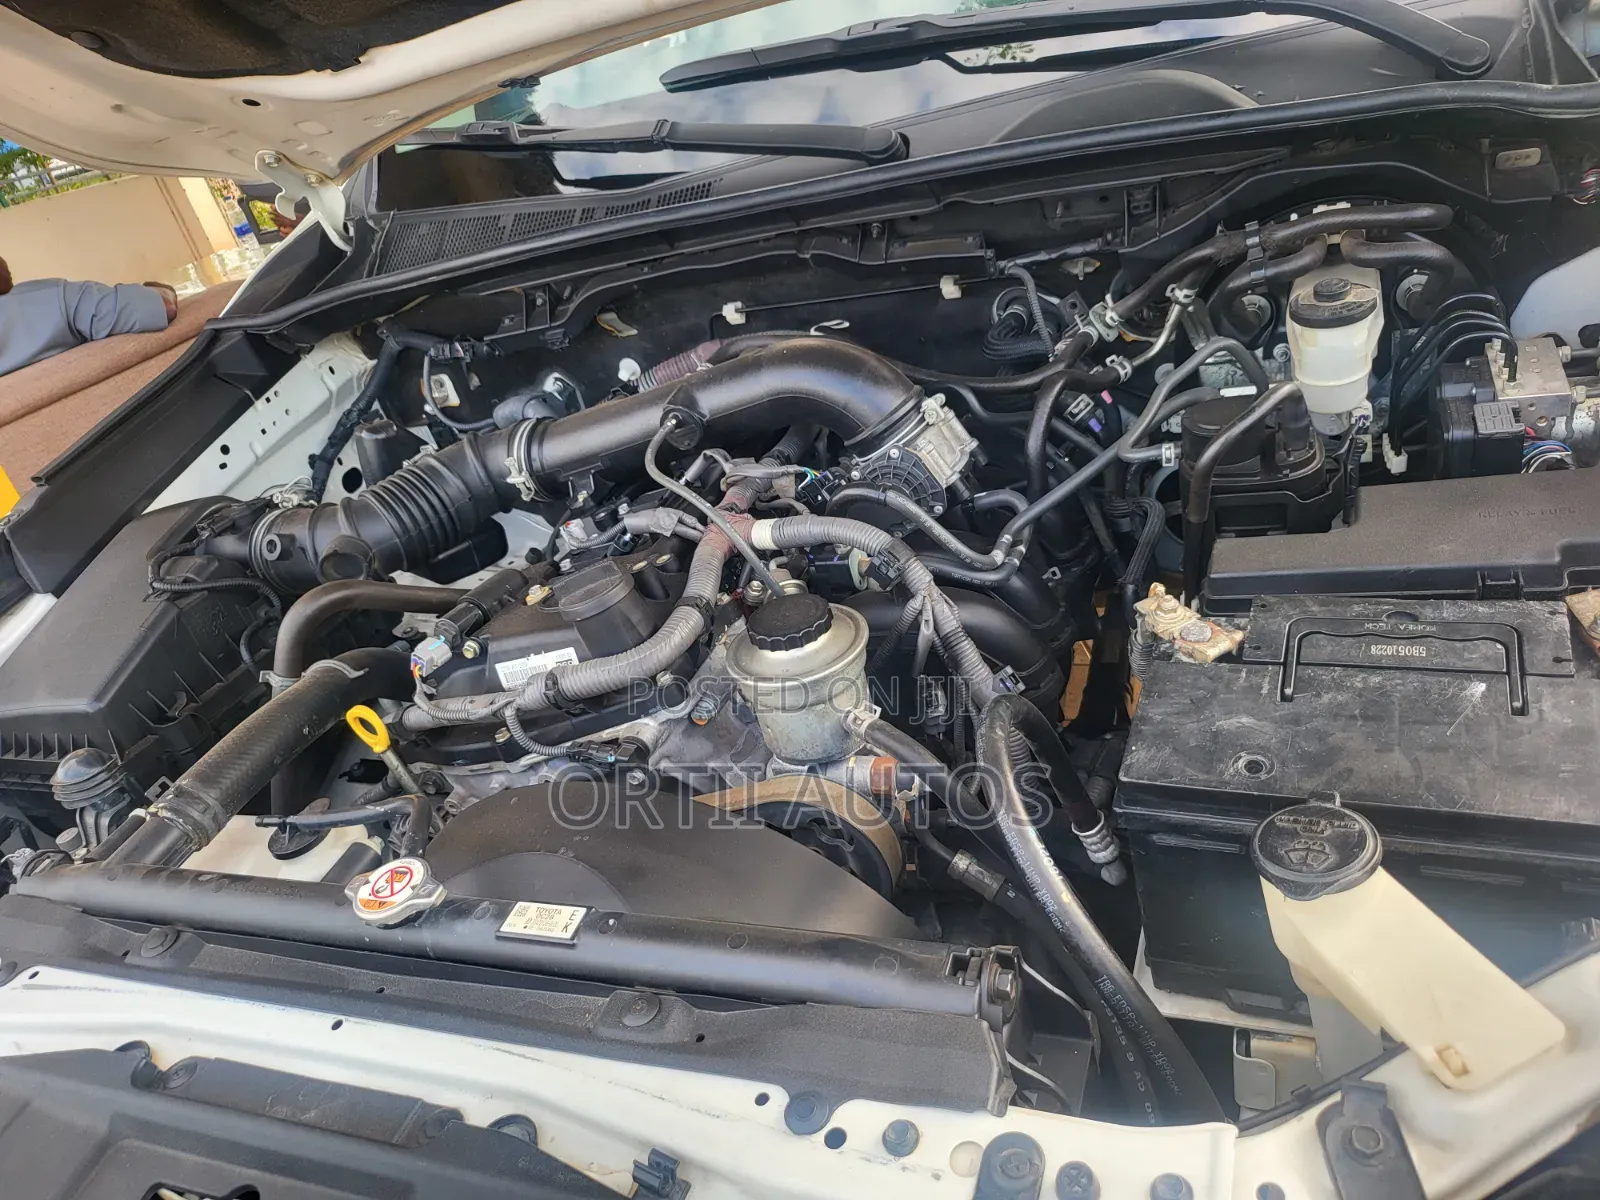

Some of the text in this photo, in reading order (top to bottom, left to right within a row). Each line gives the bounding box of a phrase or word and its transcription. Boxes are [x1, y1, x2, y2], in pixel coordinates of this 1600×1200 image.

[1364, 622, 1392, 631] TECH
[1370, 644, 1427, 657] 5B0510228
[535, 907, 563, 915] TOYOTA
[568, 910, 580, 921] E
[560, 922, 573, 933] K
